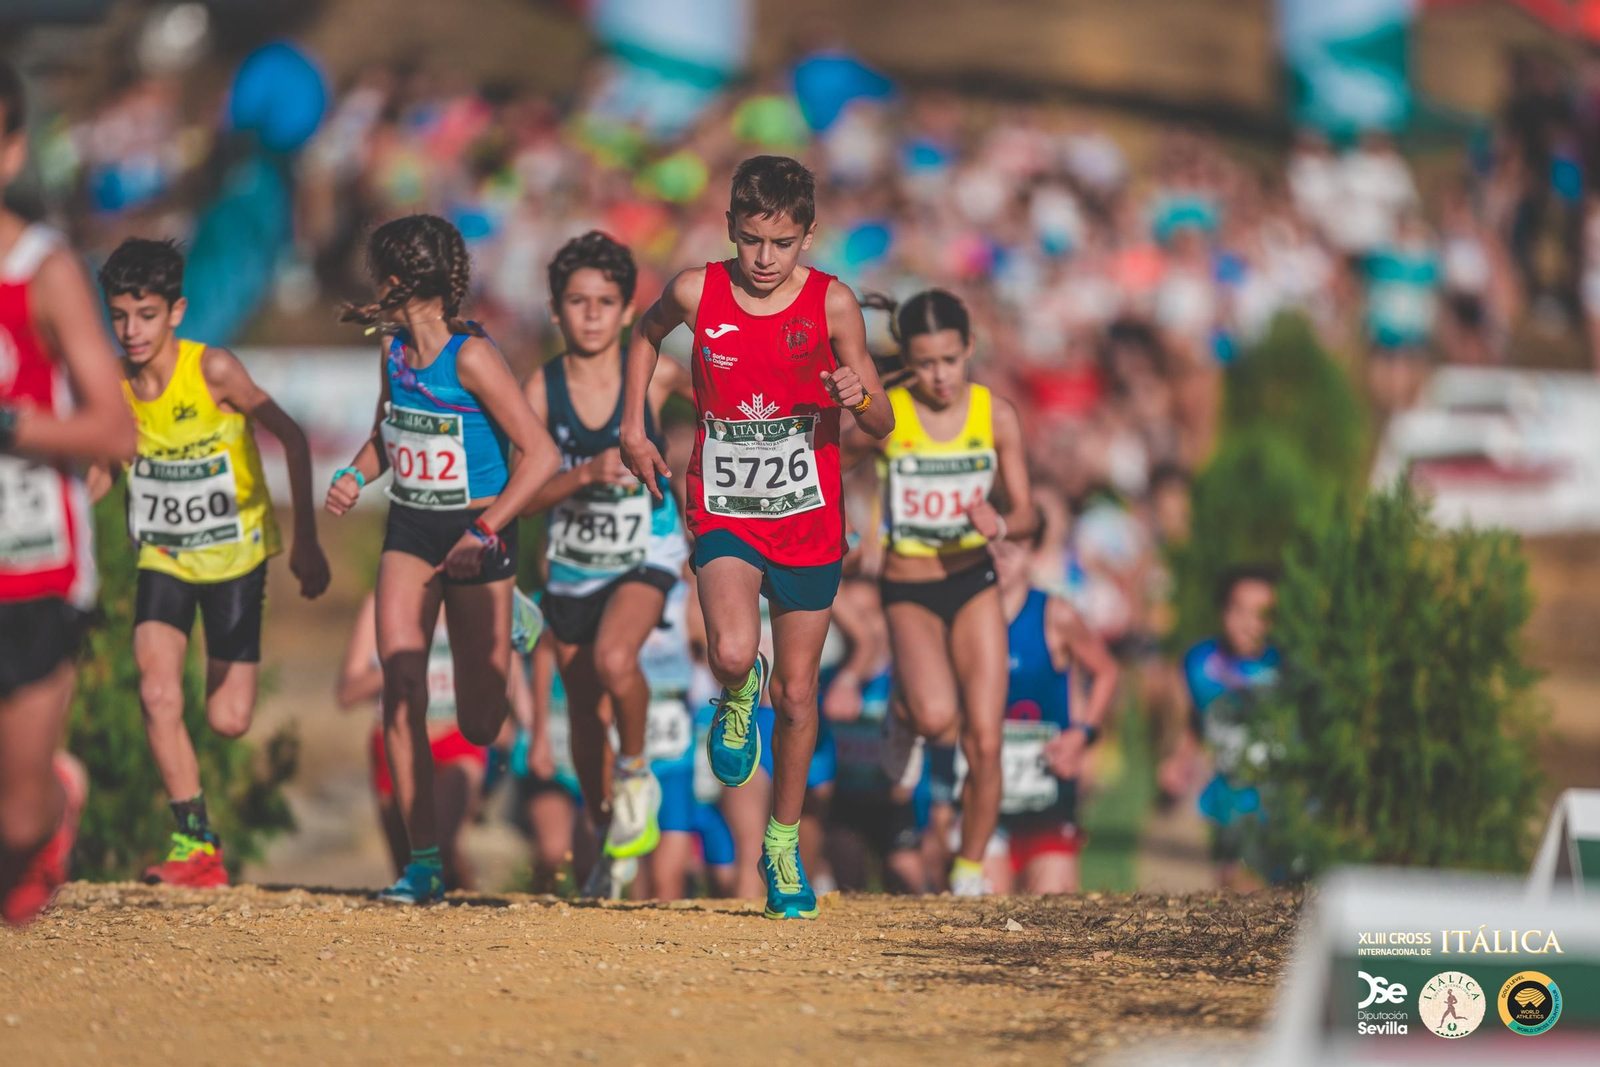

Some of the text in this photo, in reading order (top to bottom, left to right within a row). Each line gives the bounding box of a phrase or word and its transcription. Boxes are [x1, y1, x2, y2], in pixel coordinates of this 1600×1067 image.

[712, 353, 726, 361] Soria
[732, 421, 786, 436] ITÁLICA
[715, 447, 809, 490] 5726
[142, 491, 230, 525] 7860
[558, 507, 641, 543] 7847
